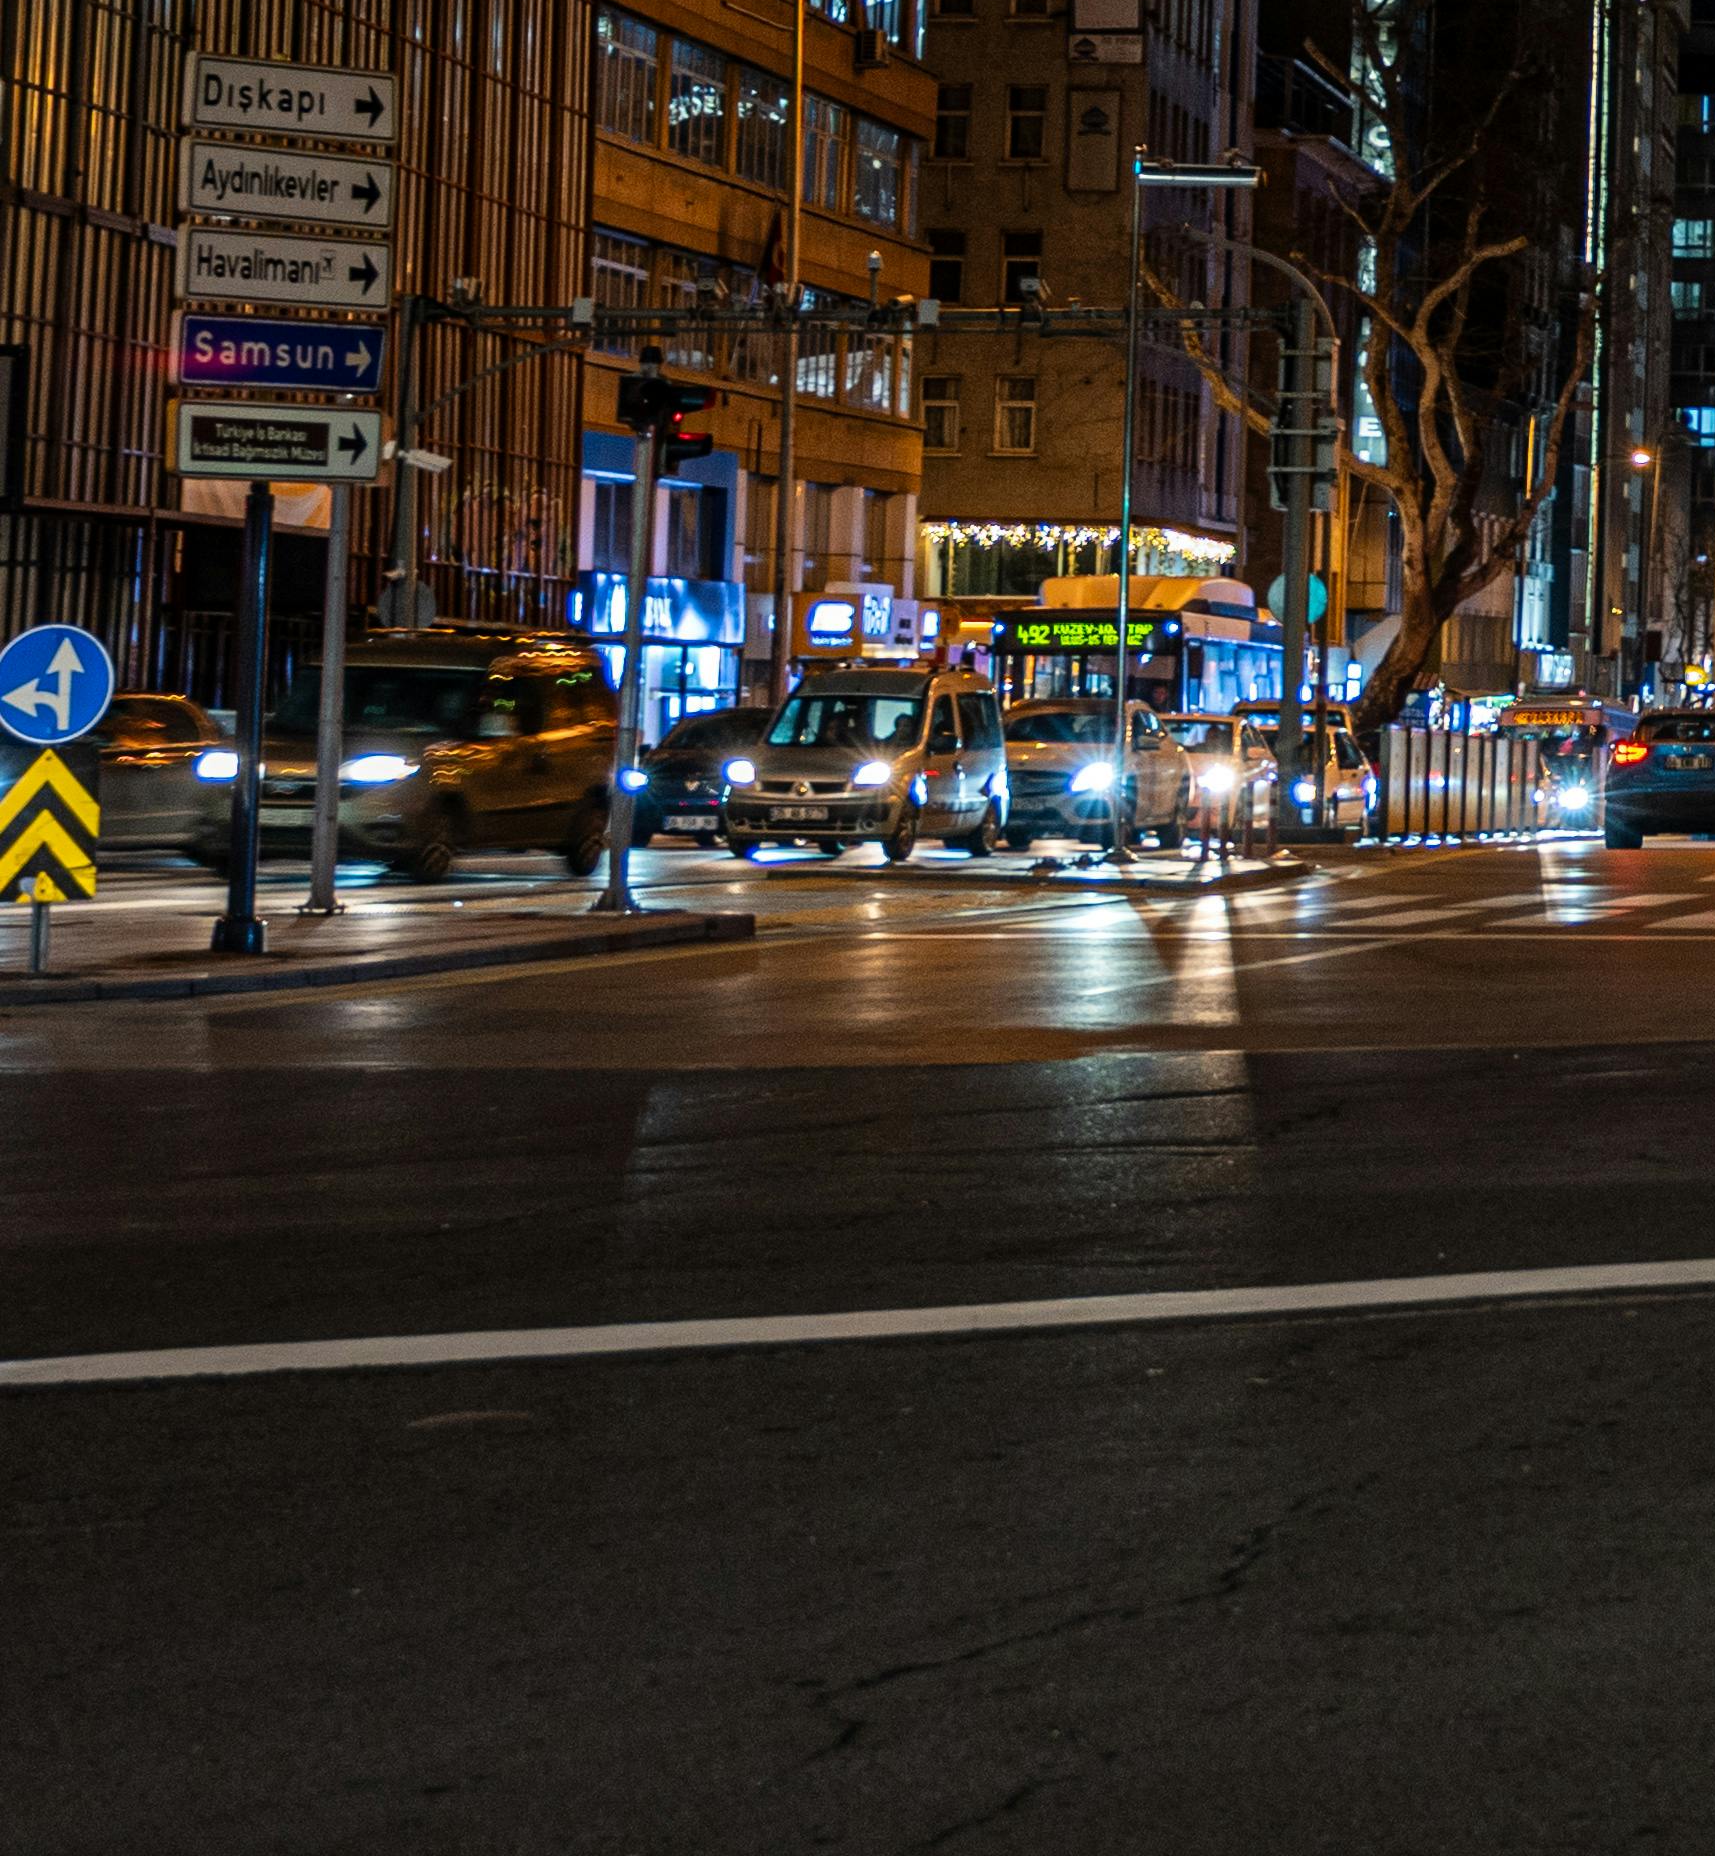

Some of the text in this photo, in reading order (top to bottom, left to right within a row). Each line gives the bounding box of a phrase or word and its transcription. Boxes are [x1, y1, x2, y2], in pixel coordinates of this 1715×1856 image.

[203, 74, 326, 122] Dışkapı
[202, 158, 339, 202] Aydınlıkevler
[196, 245, 321, 285] Havalimanı
[194, 329, 335, 371] Samsun
